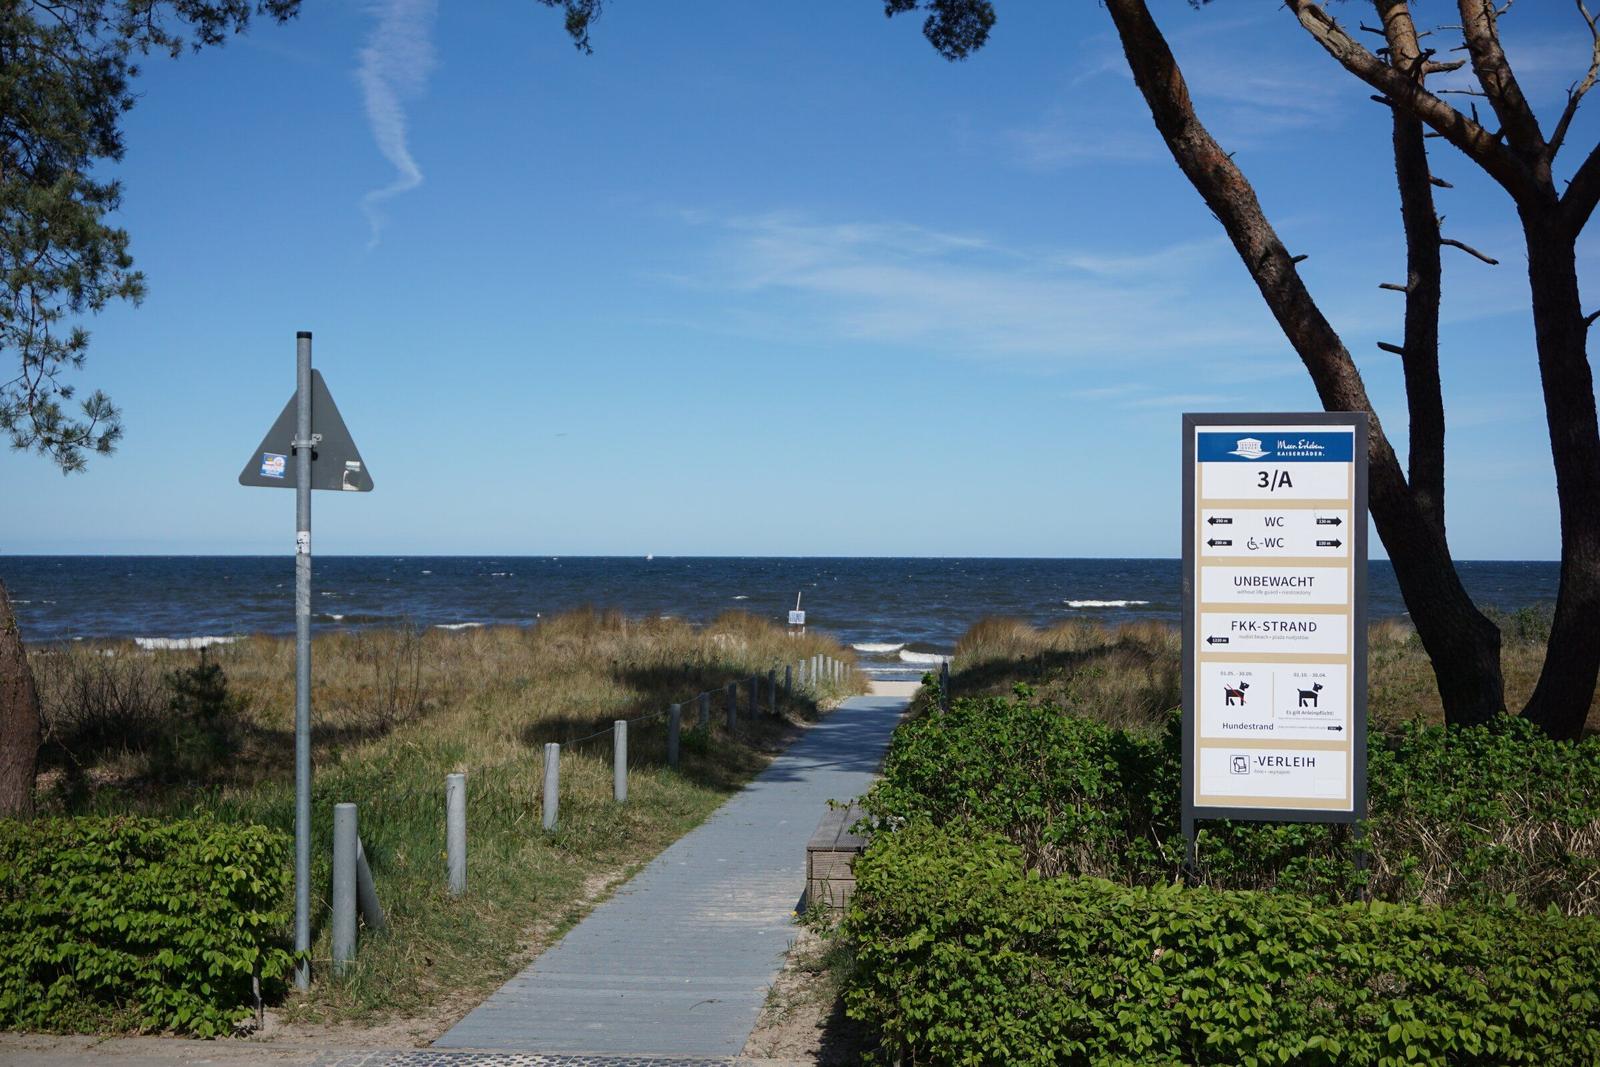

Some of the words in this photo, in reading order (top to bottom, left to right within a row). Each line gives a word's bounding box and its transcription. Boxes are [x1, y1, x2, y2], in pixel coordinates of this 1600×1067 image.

[1257, 469, 1293, 492] 3/A
[1264, 516, 1284, 527] WC
[1234, 576, 1315, 588] UNBEWACHT
[1231, 620, 1317, 633] FKK-STRAND
[1222, 722, 1274, 731] Hundestrand
[1253, 755, 1316, 768] -VERLEIH
